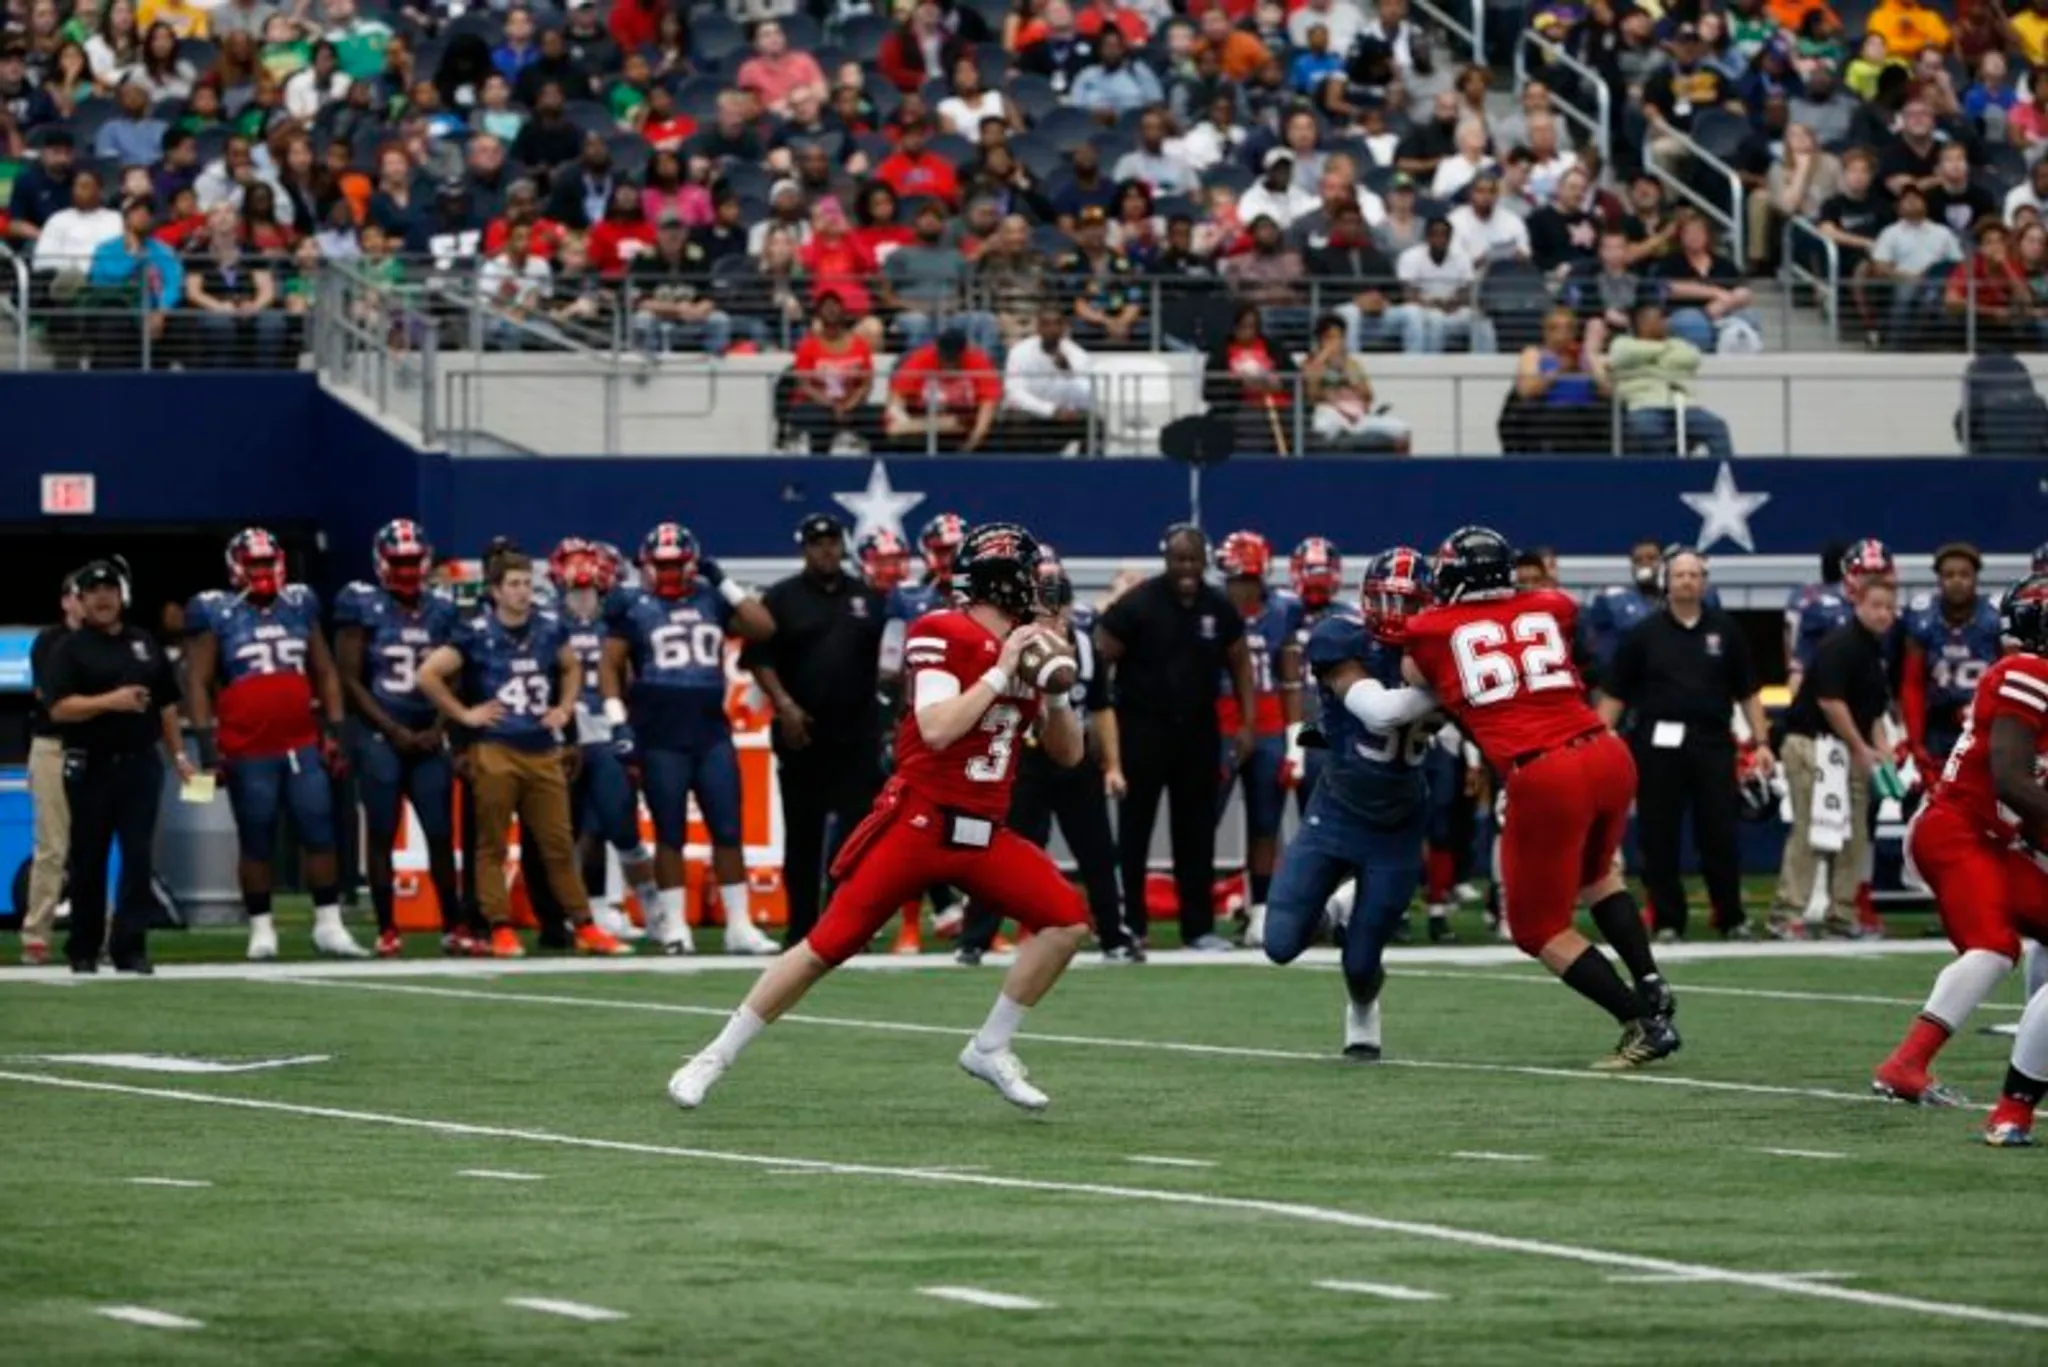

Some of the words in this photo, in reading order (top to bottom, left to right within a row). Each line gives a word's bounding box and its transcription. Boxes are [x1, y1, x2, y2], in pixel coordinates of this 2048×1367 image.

[652, 623, 722, 669] 60
[1450, 611, 1576, 707] 62
[497, 674, 550, 715] 43
[965, 703, 1021, 782] 3
